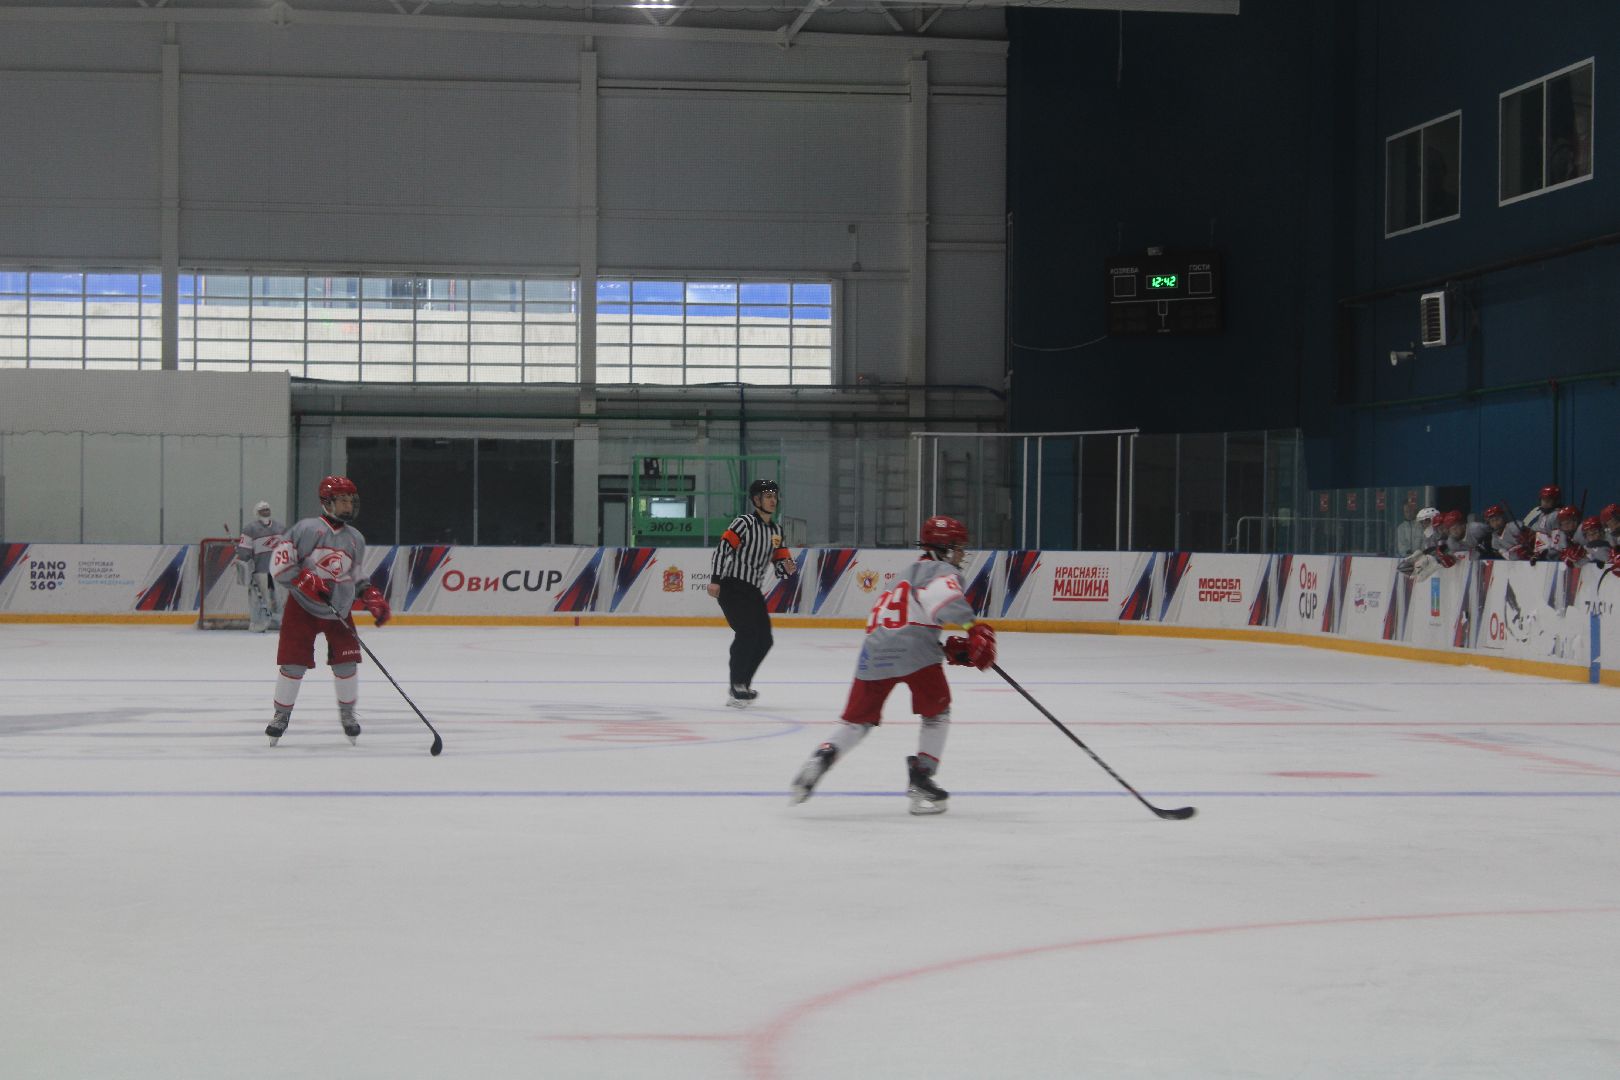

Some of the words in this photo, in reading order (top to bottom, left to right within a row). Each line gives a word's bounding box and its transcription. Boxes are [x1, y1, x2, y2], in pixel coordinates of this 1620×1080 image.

[1152, 276, 1176, 287] 12:42
[649, 522, 693, 532] ЭКО-16
[30, 561, 66, 570] PANO
[30, 571, 65, 580] RAMA
[1055, 566, 1098, 579] КРАСНАЯ
[1300, 563, 1317, 590] Ови
[691, 583, 707, 591] ГУБ
[1053, 579, 1109, 597] МАШИНА
[1199, 578, 1241, 590] МОСОБЛ
[1199, 591, 1231, 602] СПОРТ
[1299, 592, 1318, 619] CUP
[1490, 612, 1507, 641] Ов
